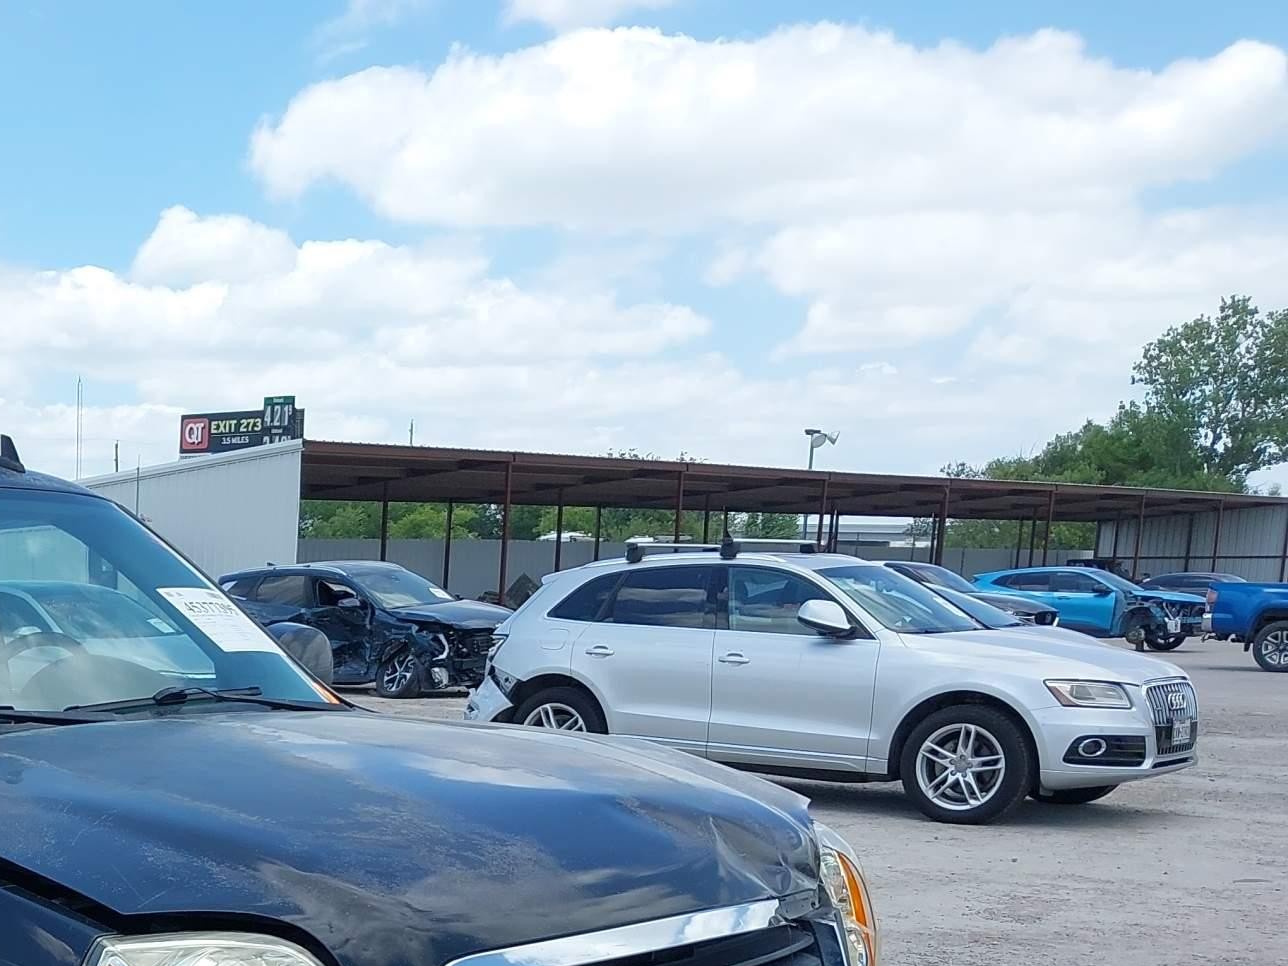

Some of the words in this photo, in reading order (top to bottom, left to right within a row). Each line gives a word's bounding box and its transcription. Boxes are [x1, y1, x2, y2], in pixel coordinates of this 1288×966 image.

[185, 423, 205, 445] QT
[211, 420, 237, 434] EXIT
[240, 418, 262, 432] 273
[232, 436, 249, 444] MILES
